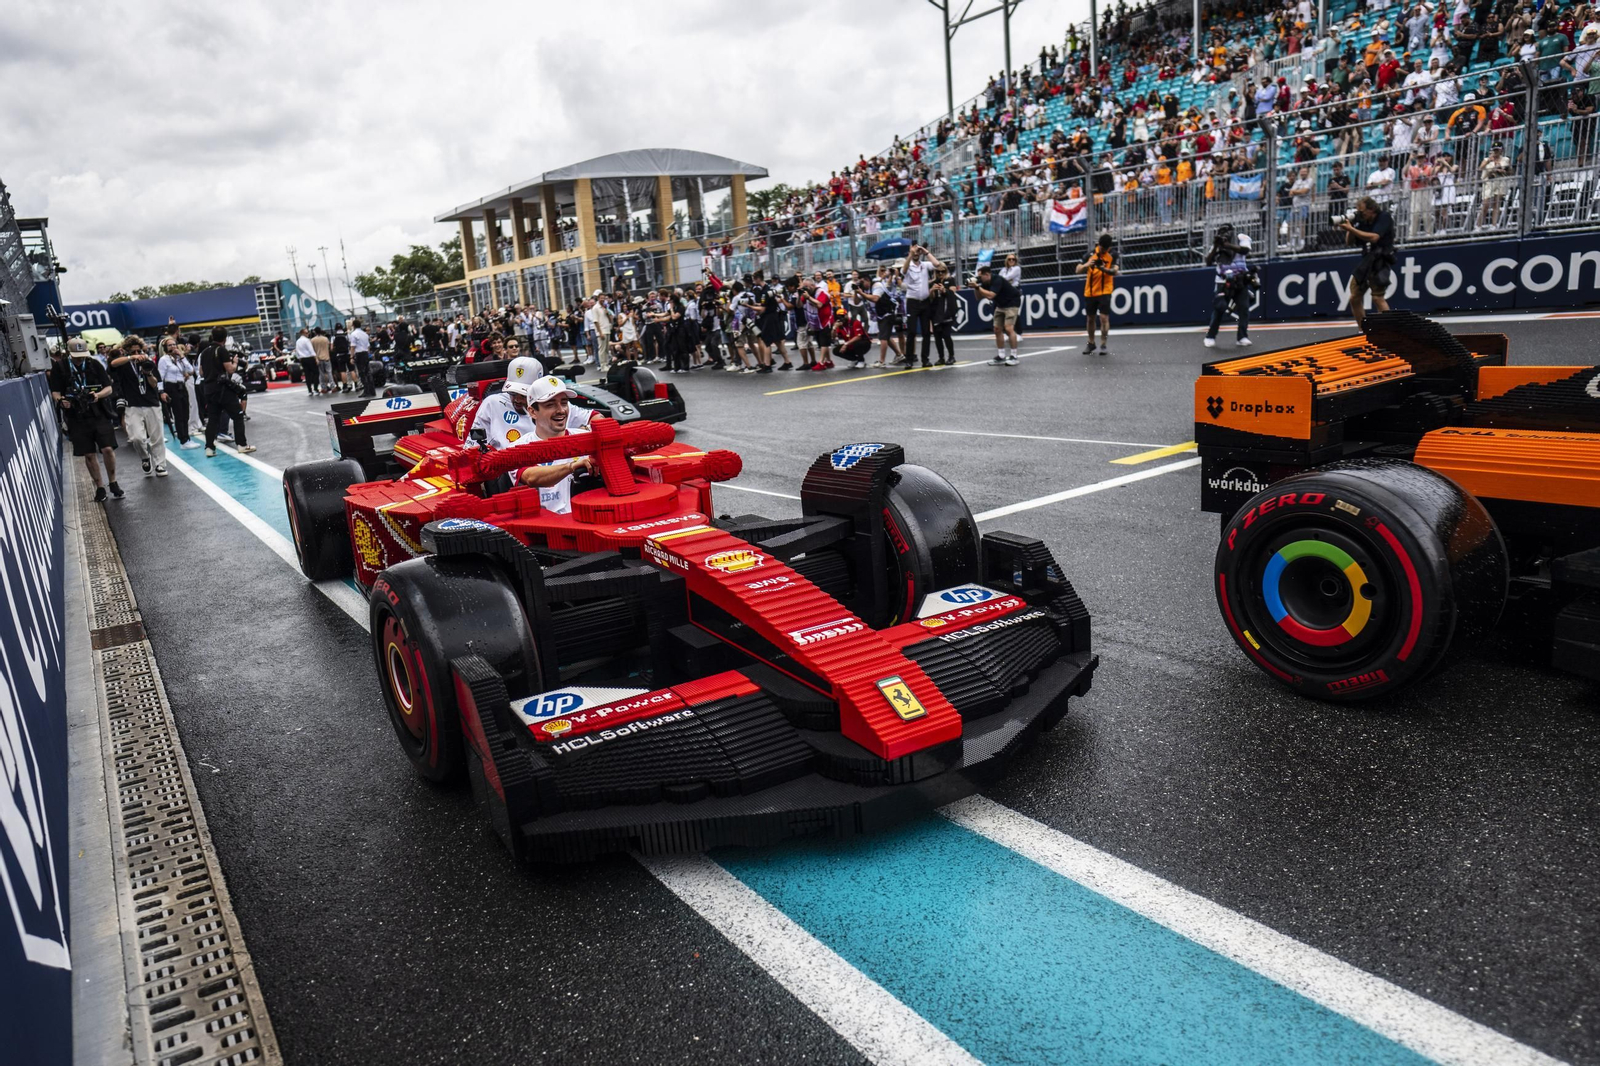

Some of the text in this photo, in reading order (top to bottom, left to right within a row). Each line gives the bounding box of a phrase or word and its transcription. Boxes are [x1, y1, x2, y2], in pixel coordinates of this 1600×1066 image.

[287, 293, 318, 328] 19
[977, 284, 1168, 326] cpto.om
[1230, 401, 1295, 417] Dropbox
[541, 491, 560, 503] IBM
[1227, 528, 1237, 551] P
[1242, 492, 1326, 530] ZERO
[668, 554, 689, 571] MILLE
[953, 588, 984, 604] hp
[788, 617, 864, 646] PIRELLI
[1326, 668, 1390, 695] PIRELLI
[536, 693, 574, 718] hp
[552, 708, 696, 756] HCLSoftware
